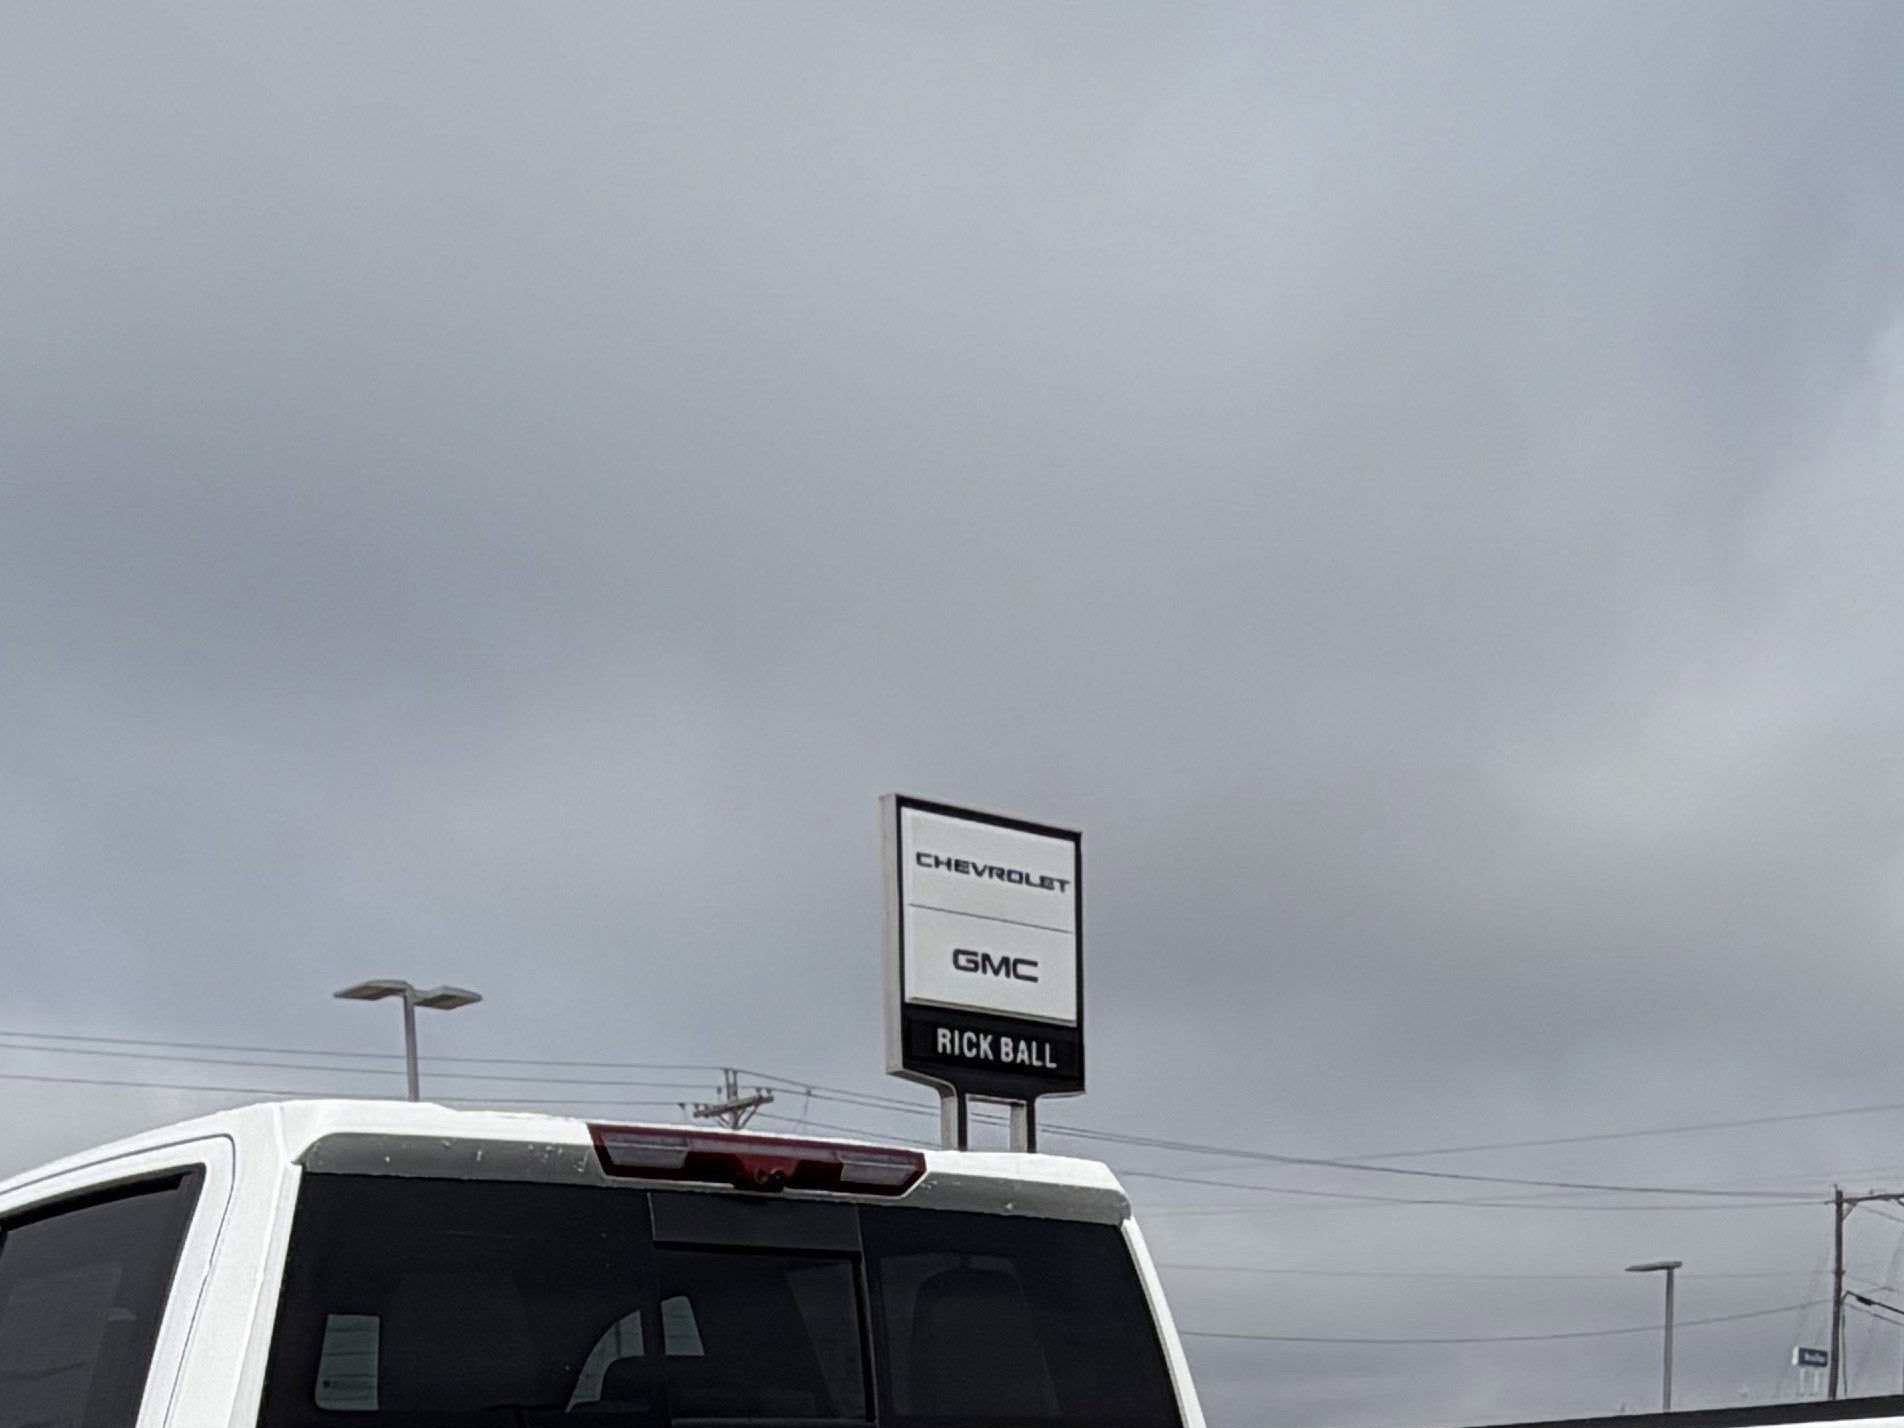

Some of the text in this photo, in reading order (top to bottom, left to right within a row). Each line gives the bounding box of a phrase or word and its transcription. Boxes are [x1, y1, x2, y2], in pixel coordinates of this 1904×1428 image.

[915, 850, 1071, 894] CHEVROLET
[952, 947, 1039, 984] GMC
[936, 1026, 1058, 1069] RICK BALL
